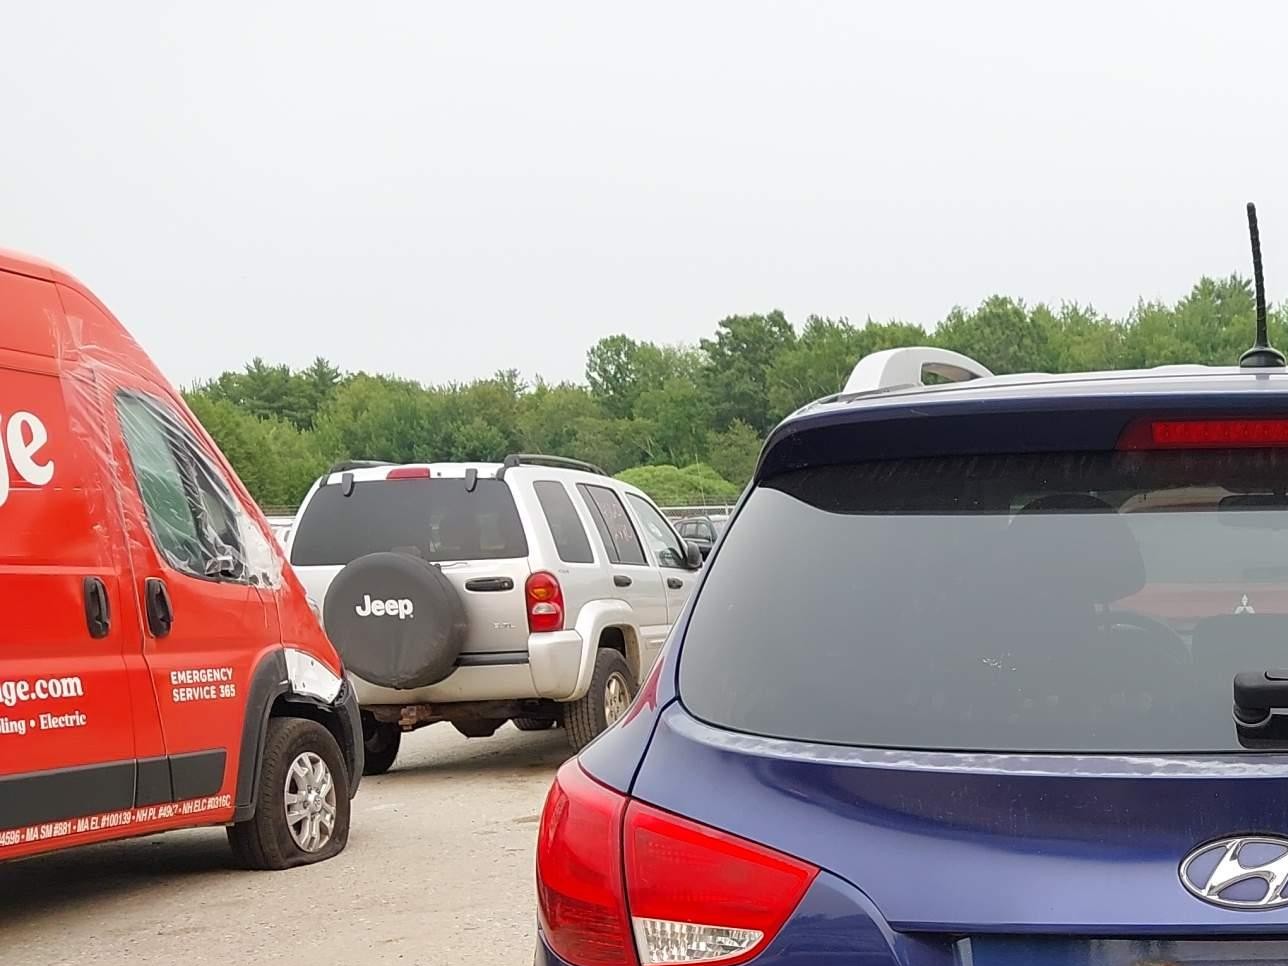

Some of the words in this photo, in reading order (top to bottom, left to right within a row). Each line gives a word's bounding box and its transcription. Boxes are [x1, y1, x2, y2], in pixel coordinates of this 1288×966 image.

[356, 595, 414, 619] Jeep
[170, 667, 233, 685] EMERGENCY
[0, 677, 84, 707] ge.com
[172, 685, 217, 702] SERVICE
[219, 684, 236, 698] 365
[39, 710, 87, 730] Electric
[26, 826, 39, 841] MA
[40, 824, 53, 839] SM
[77, 818, 89, 833] MA
[90, 816, 101, 830] EL
[101, 811, 131, 827] #100139
[136, 808, 148, 823] NH
[148, 806, 157, 820] PL
[182, 801, 193, 815] NH
[193, 798, 207, 812] ELC
